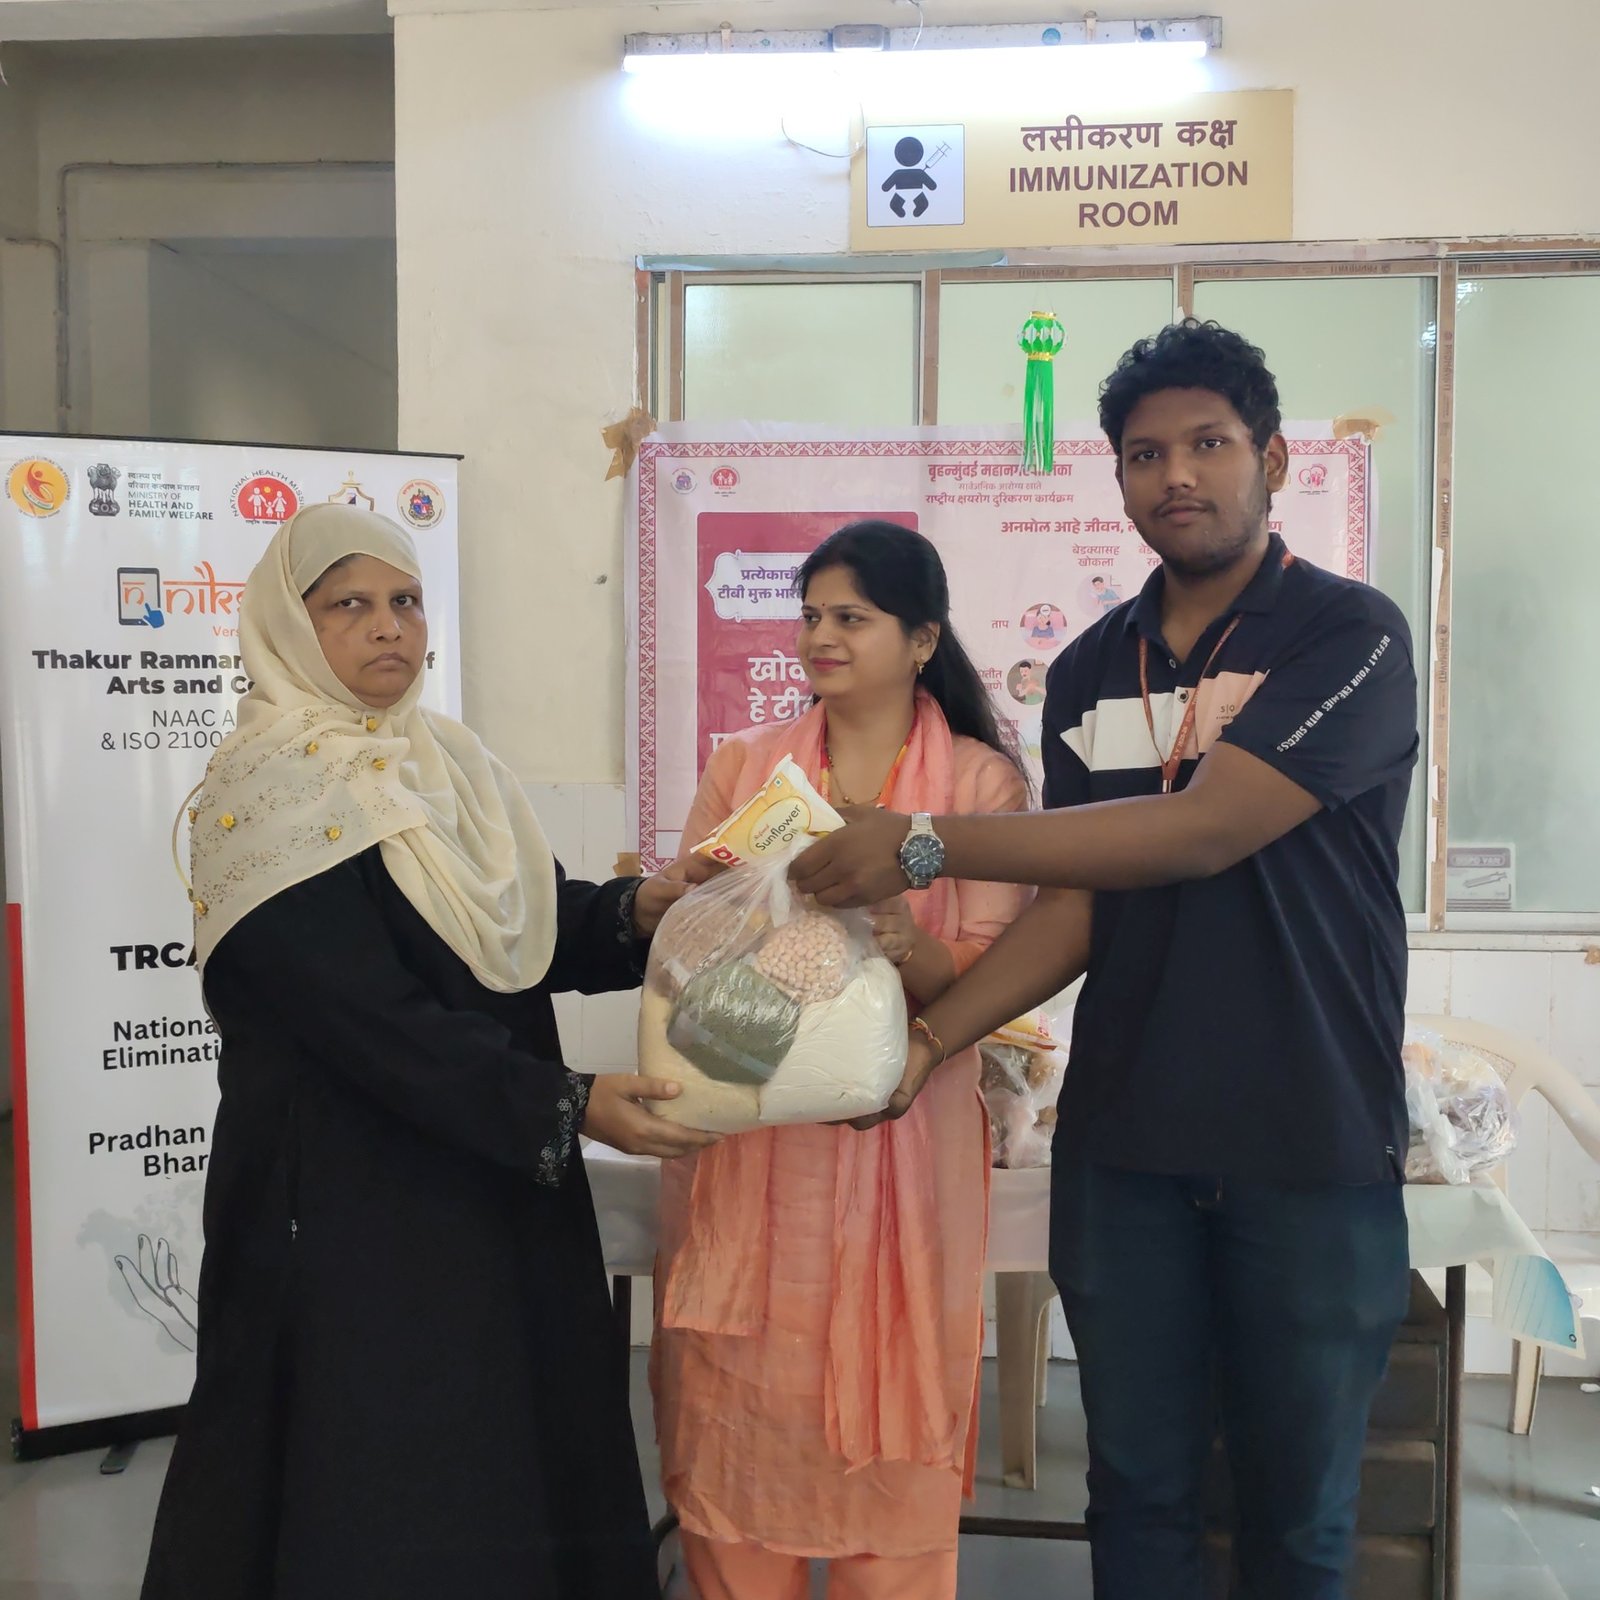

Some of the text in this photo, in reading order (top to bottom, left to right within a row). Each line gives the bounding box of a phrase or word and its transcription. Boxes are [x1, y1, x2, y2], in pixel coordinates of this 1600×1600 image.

[1020, 114, 1238, 153] लसीकरण कक्ष
[1008, 160, 1249, 193] IMMUNIZATION
[1078, 200, 1179, 228] ROOM
[128, 491, 181, 501] MINISTRY OF
[229, 475, 250, 517] NATIONAL
[251, 469, 288, 482] HEALTH
[926, 490, 1075, 508] राष्ट्रीय क्षयरोग दुरिकरण कार्यक्रम
[128, 499, 194, 510] HEALTH AND
[128, 509, 214, 520] FAMILY WELFARE
[1001, 517, 1052, 534] अनमोल
[1054, 517, 1081, 534] आहे
[1084, 517, 1124, 534] जीवन,
[1072, 543, 1121, 556] बेडक्यासह
[1078, 556, 1115, 567] खोकला
[717, 584, 746, 600] टीबी
[748, 587, 772, 604] मुक्त
[991, 619, 1009, 629] ताप
[31, 649, 133, 670] Thakur
[106, 676, 166, 695] Arts
[173, 675, 223, 694] and
[1276, 634, 1391, 752] DEFEAT YOUR ENEMIES WITH SUCCESS
[747, 687, 768, 723] हे
[152, 709, 216, 728] NAAC
[101, 732, 116, 751] &
[122, 732, 161, 751] ISO
[755, 804, 801, 851] Sunflower
[782, 828, 799, 844] Oil
[89, 1124, 206, 1155] Pradhan
[143, 1152, 209, 1177] Bhar
